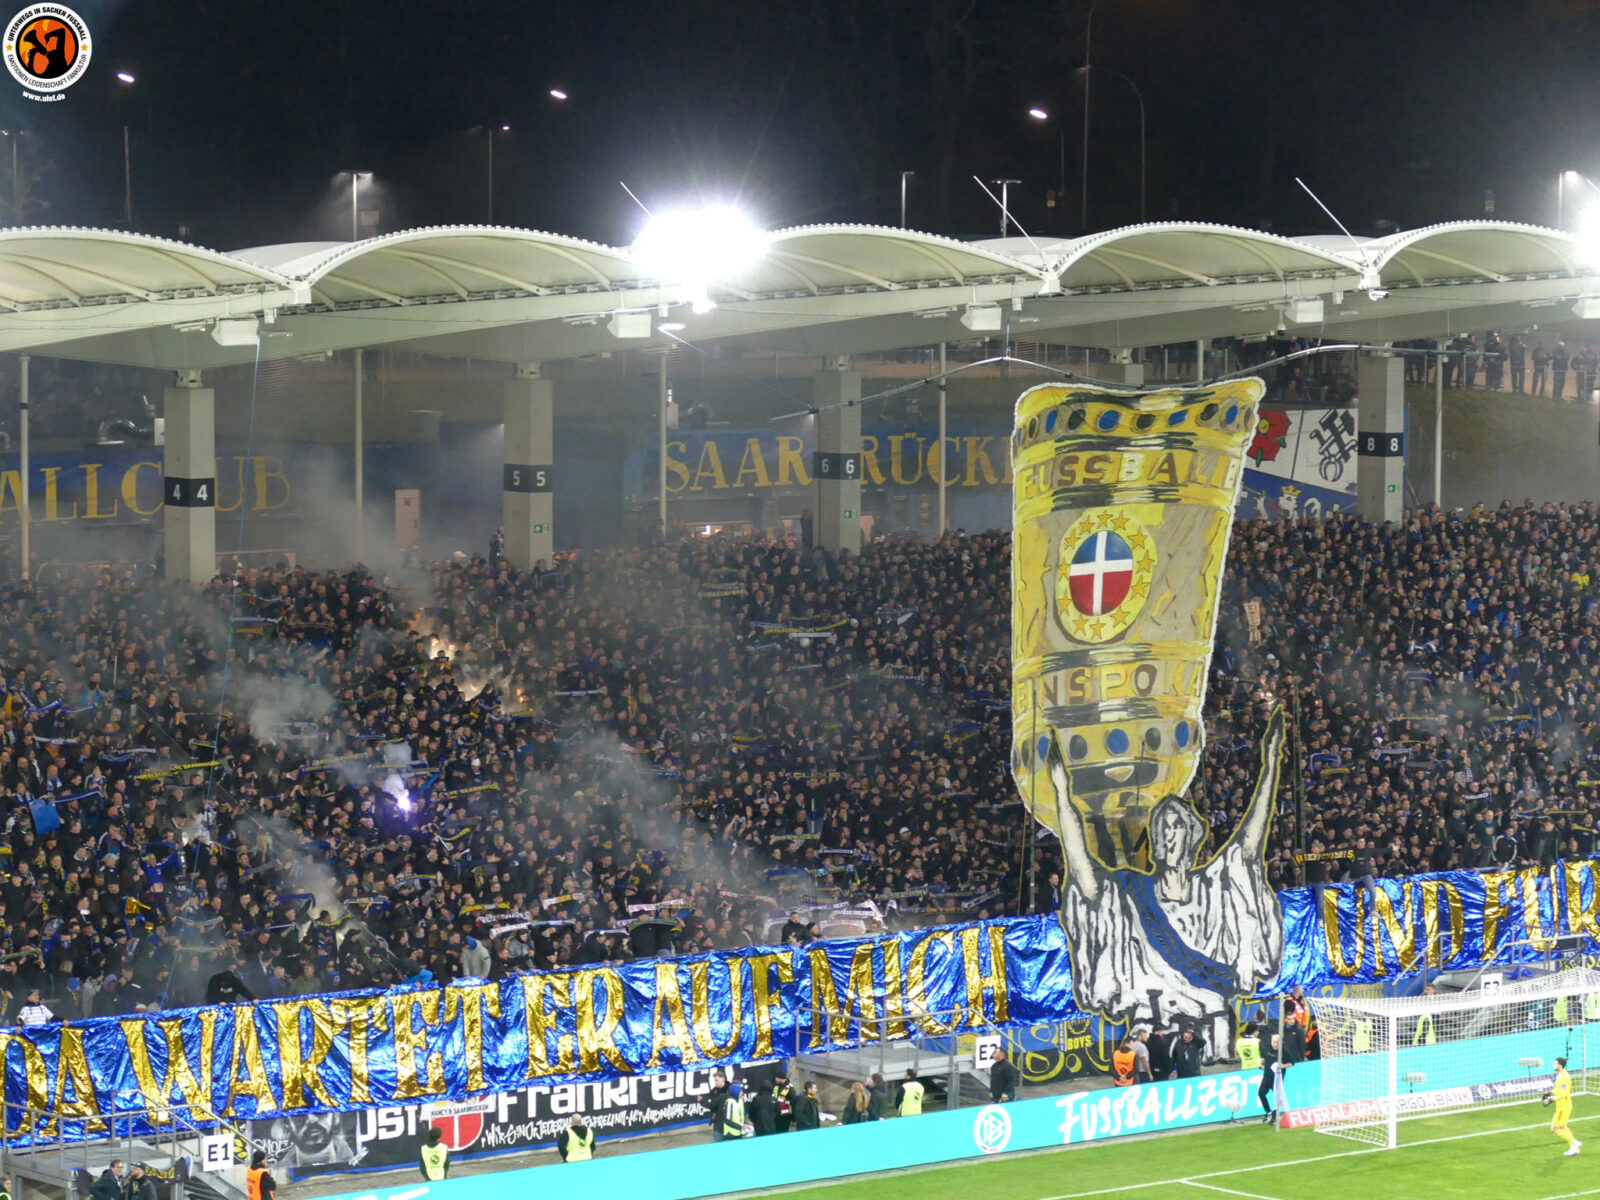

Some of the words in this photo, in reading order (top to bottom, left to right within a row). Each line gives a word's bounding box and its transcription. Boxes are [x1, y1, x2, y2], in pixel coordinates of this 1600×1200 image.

[1391, 438, 1399, 451] 8
[845, 459, 855, 474] 6
[536, 470, 546, 487] 5
[197, 484, 208, 501] 4
[120, 982, 502, 1126] WARTET
[521, 967, 633, 1079] ER
[646, 951, 795, 1067] AUF
[808, 926, 1010, 1049] MICH
[1323, 880, 1465, 977] UND
[1067, 1034, 1092, 1051] BOYS
[979, 1043, 998, 1061] E2
[208, 1142, 230, 1163] E1
